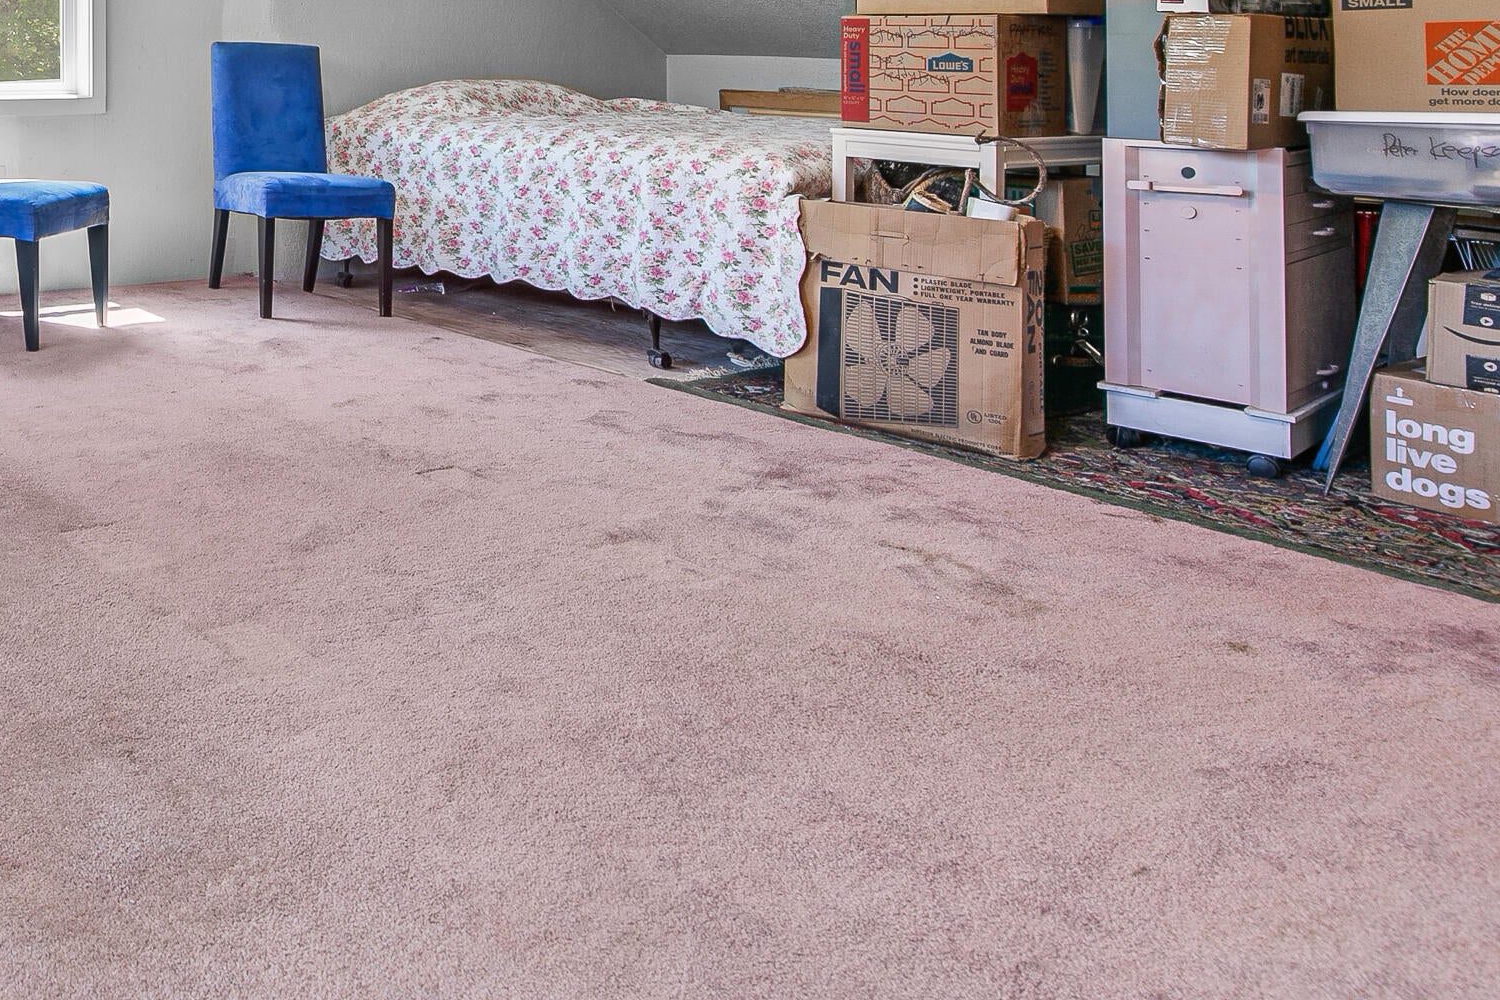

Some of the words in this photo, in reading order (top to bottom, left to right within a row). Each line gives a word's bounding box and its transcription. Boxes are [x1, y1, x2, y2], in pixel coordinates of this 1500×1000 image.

[1434, 27, 1471, 54] THE
[1427, 24, 1500, 85] HOM
[848, 41, 865, 93] small
[932, 61, 969, 70] LOWE'S
[1441, 87, 1469, 96] How
[1429, 98, 1449, 107] get
[820, 260, 899, 294] FAN
[920, 278, 948, 286] PLASTIC
[950, 281, 973, 289] BLADE
[920, 285, 968, 295] LIGHTWEIGHT,
[970, 290, 1005, 299] PORTABLE
[955, 295, 973, 303] YEAR
[976, 297, 1015, 307] WARRANTY
[977, 329, 989, 337] TAN
[991, 330, 1007, 338] BODY
[970, 338, 993, 347] ALMOND
[996, 340, 1014, 349] BLADE
[975, 348, 987, 356] AND
[1386, 409, 1475, 455] long
[1386, 437, 1458, 474] live
[1385, 467, 1491, 510] dogs
